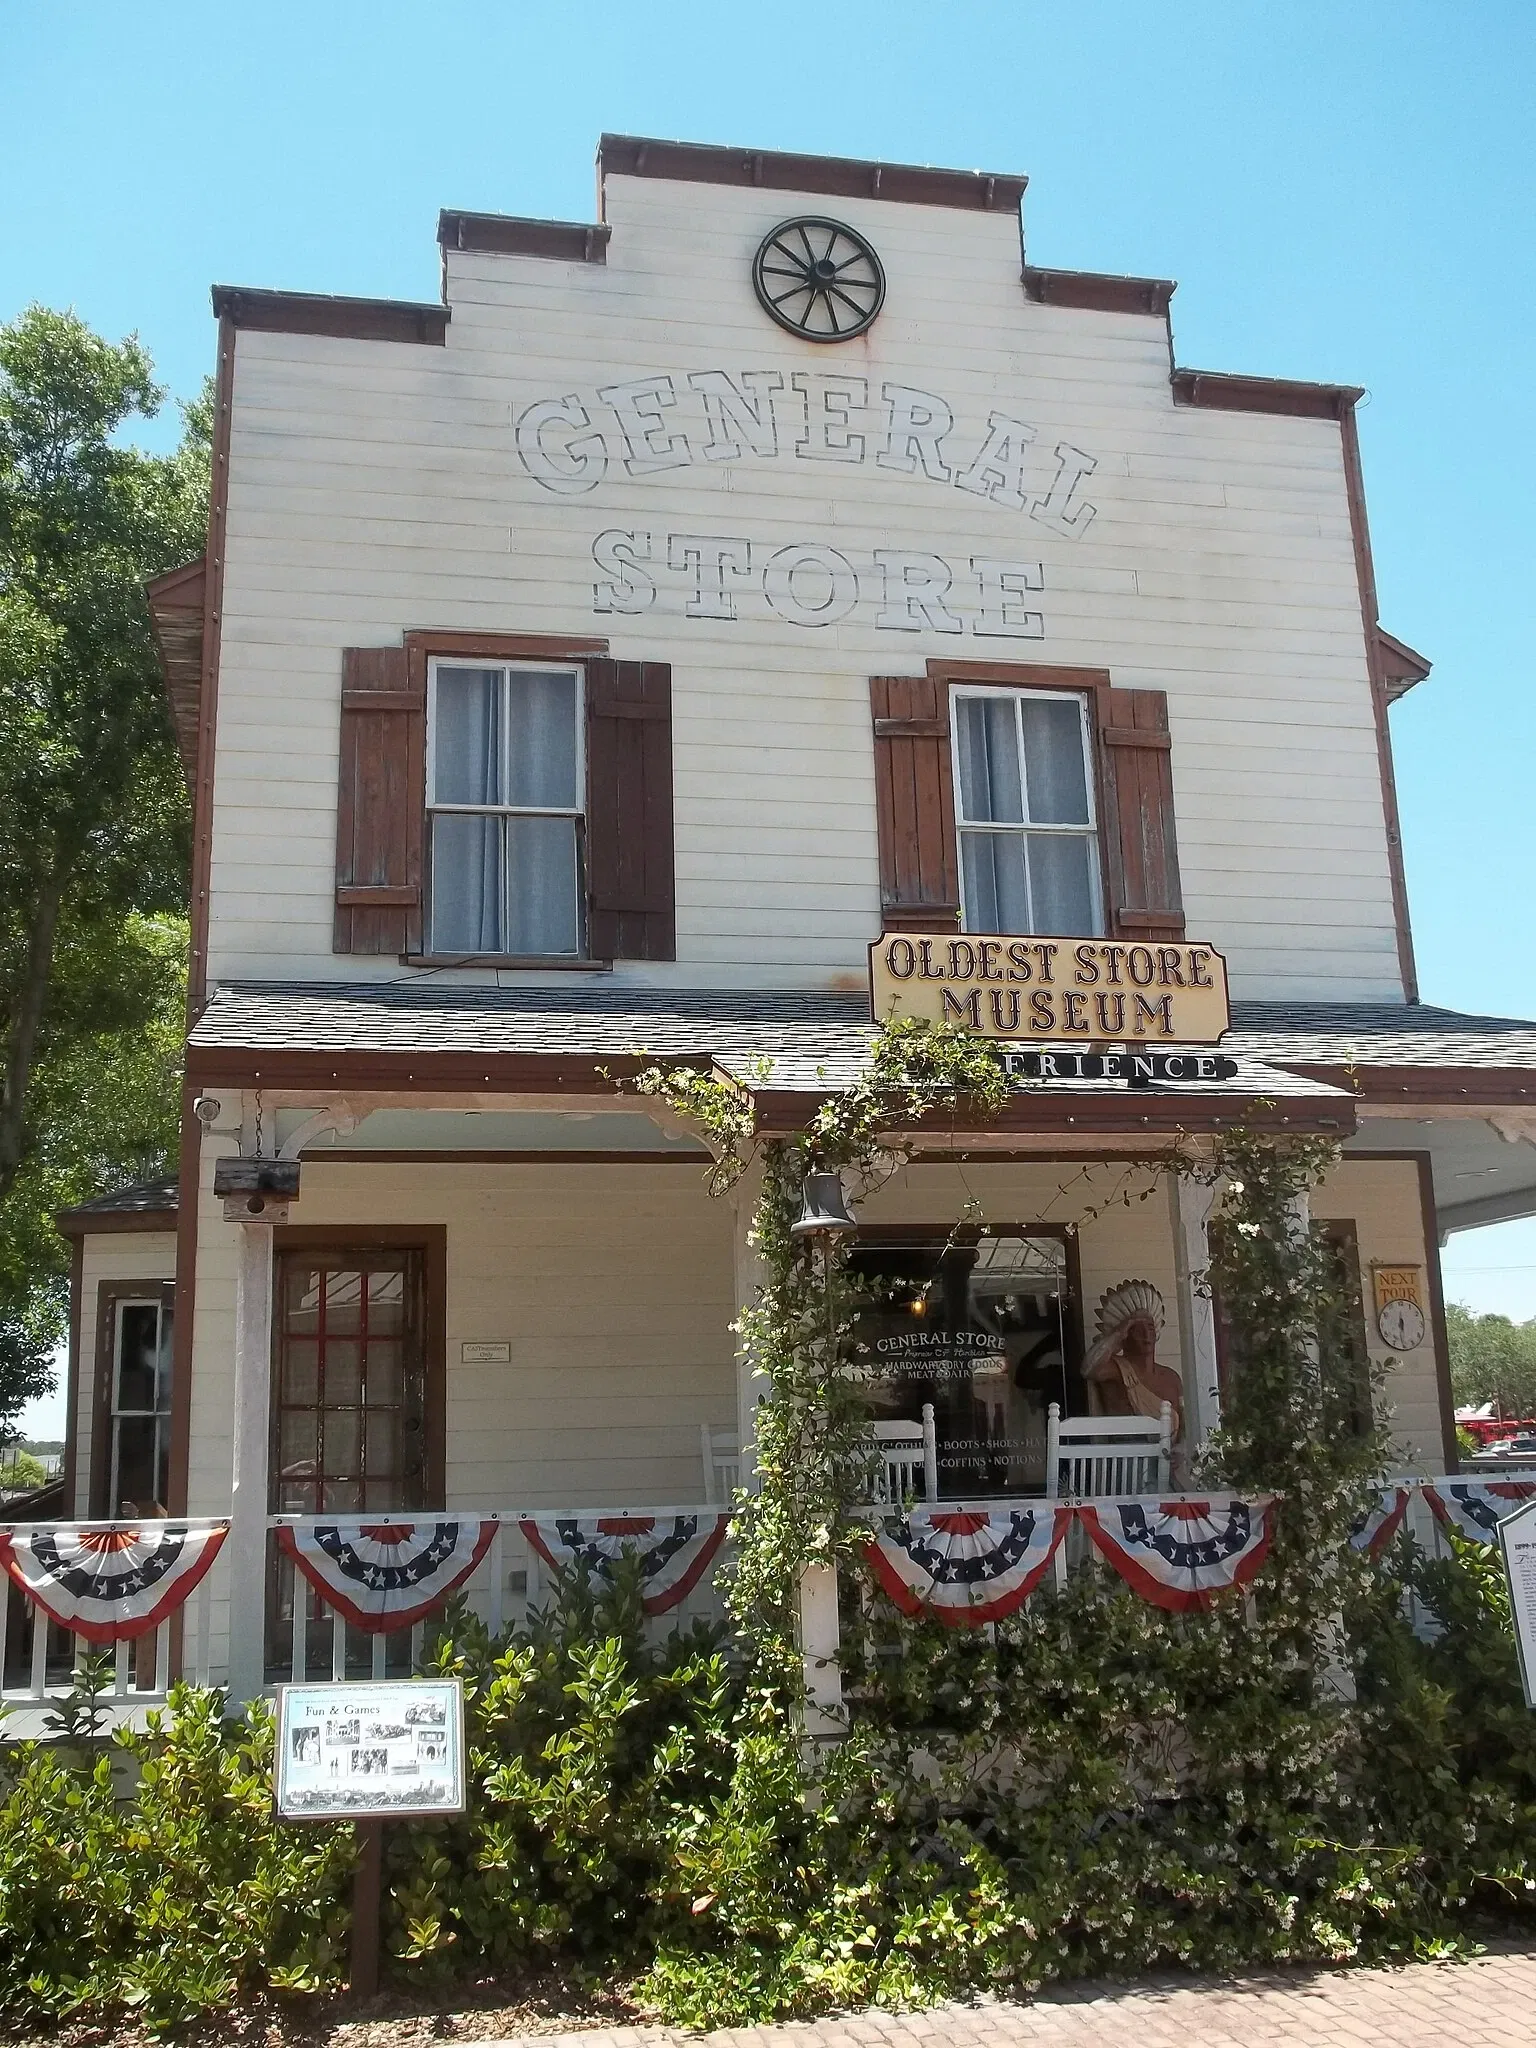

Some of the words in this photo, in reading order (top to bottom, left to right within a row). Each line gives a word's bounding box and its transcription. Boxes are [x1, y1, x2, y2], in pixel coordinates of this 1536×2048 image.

[514, 370, 1098, 540] GENERAL
[592, 528, 1045, 640] STORE
[886, 937, 1058, 984] OLDEST
[1074, 943, 1215, 989] STORE
[940, 986, 1176, 1036] MUSEUM
[1379, 1272, 1417, 1286] NEXT
[1379, 1287, 1418, 1304] TOUR
[876, 1331, 952, 1352] GENERAL
[955, 1332, 1006, 1350] STORE
[907, 1370, 935, 1379] MEAT
[943, 1439, 980, 1450] BOOTS
[985, 1439, 1019, 1449] SHOES
[939, 1456, 987, 1468] COFFINS
[993, 1454, 1043, 1467] NOTIONS
[305, 1705, 325, 1717] Fun
[329, 1705, 339, 1715] &
[344, 1704, 381, 1715] Games
